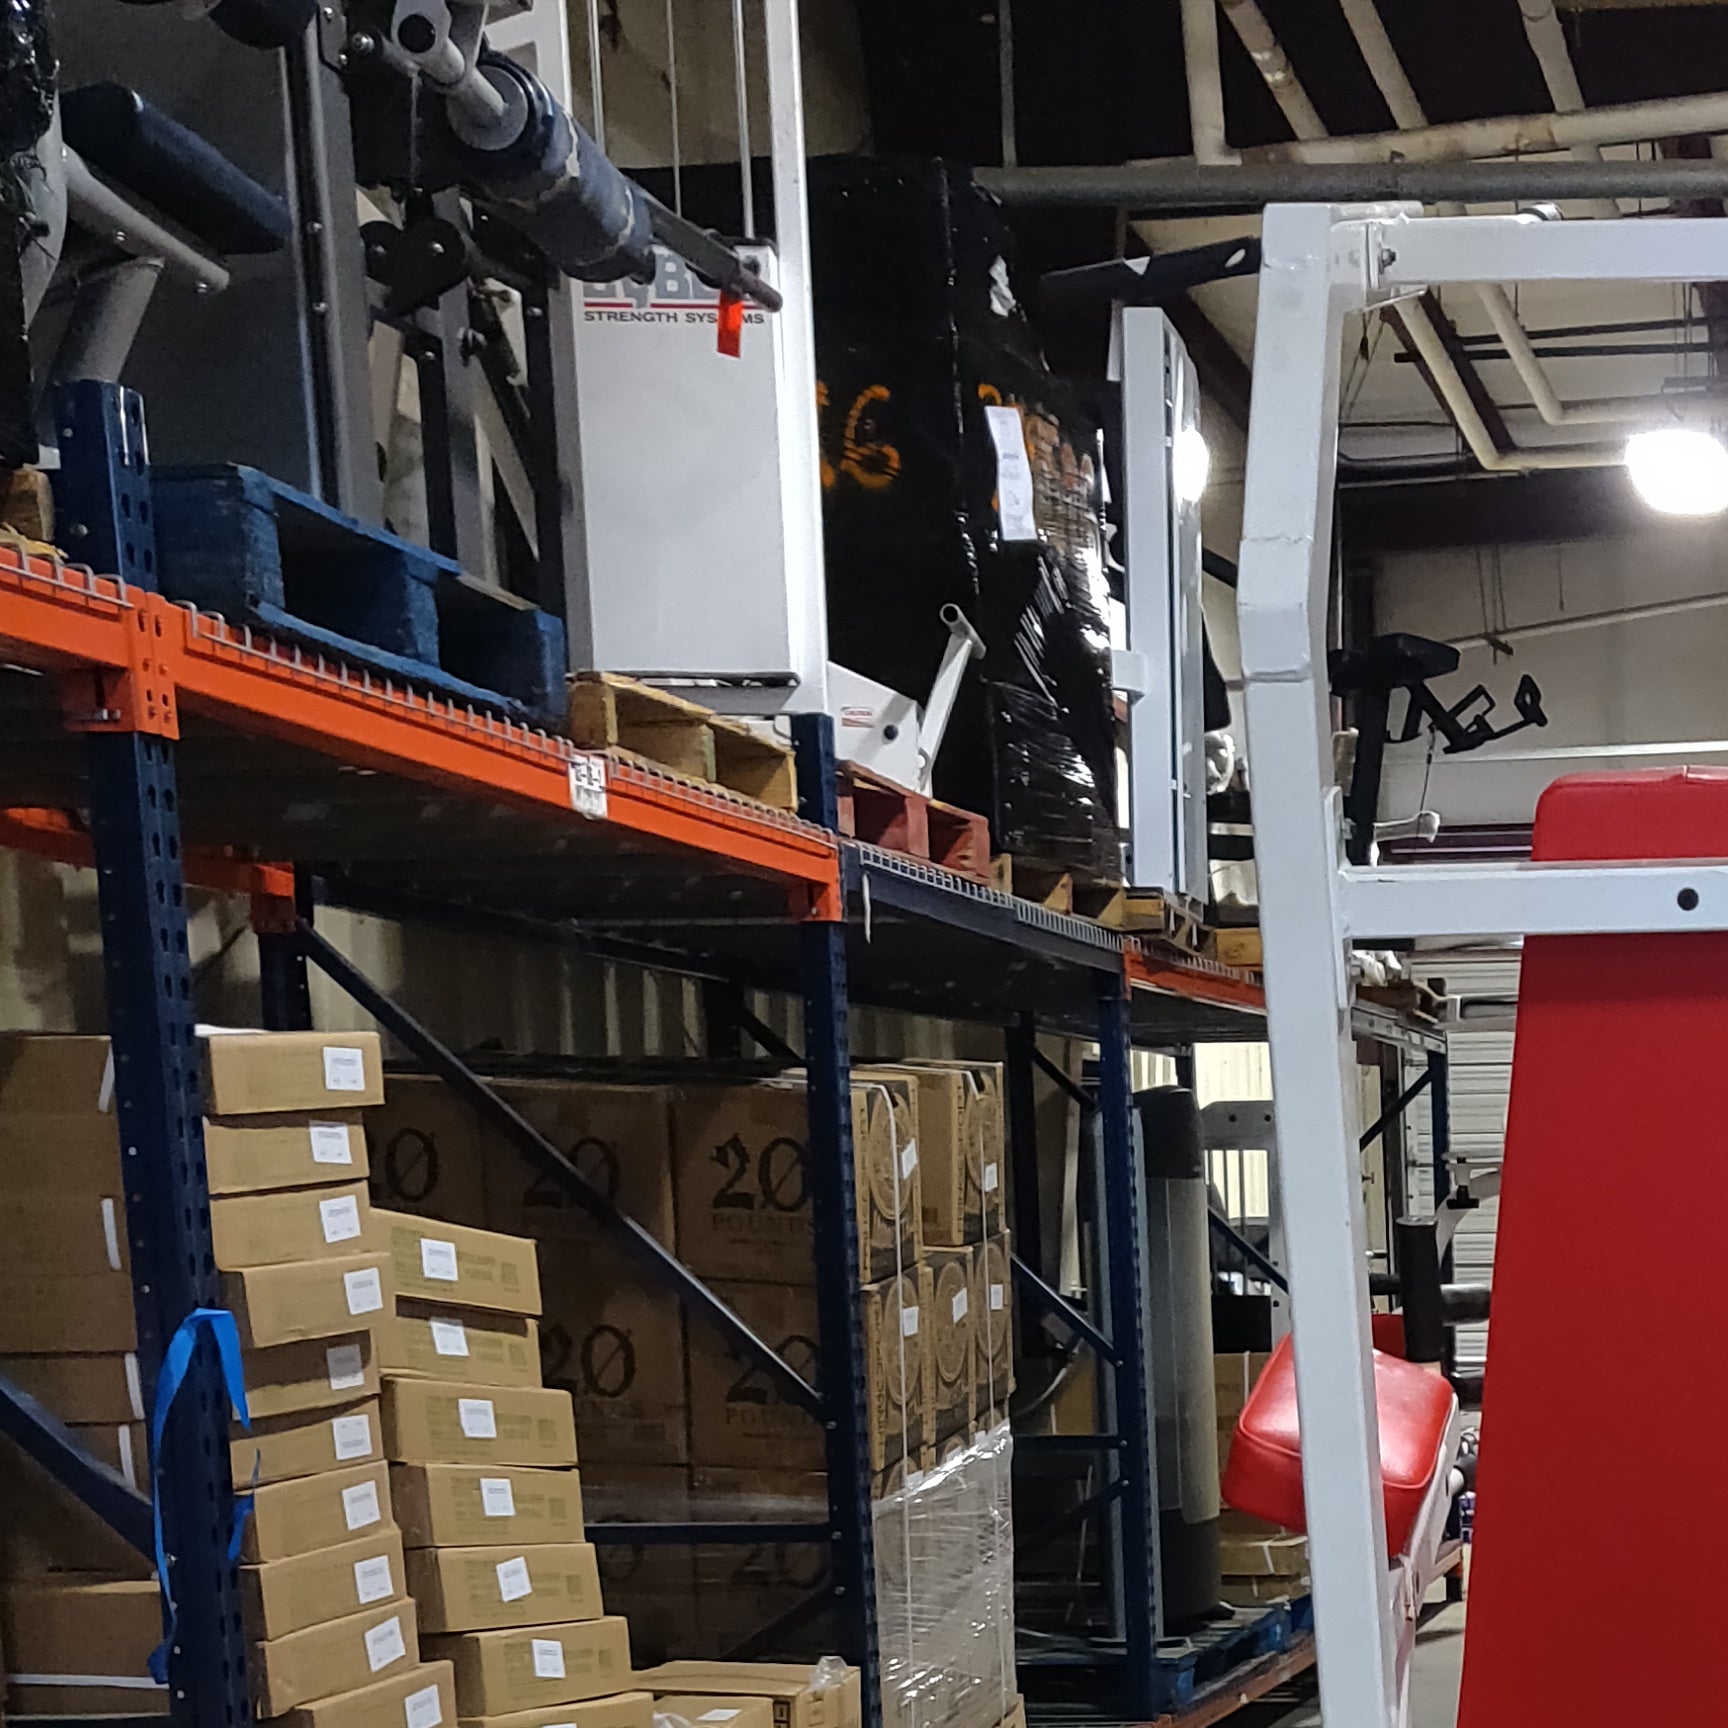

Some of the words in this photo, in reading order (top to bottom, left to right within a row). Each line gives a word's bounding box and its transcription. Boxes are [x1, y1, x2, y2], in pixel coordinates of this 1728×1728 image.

[584, 310, 679, 324] STRENGTH
[684, 312, 766, 325] SYSMS
[709, 1132, 808, 1212] 20
